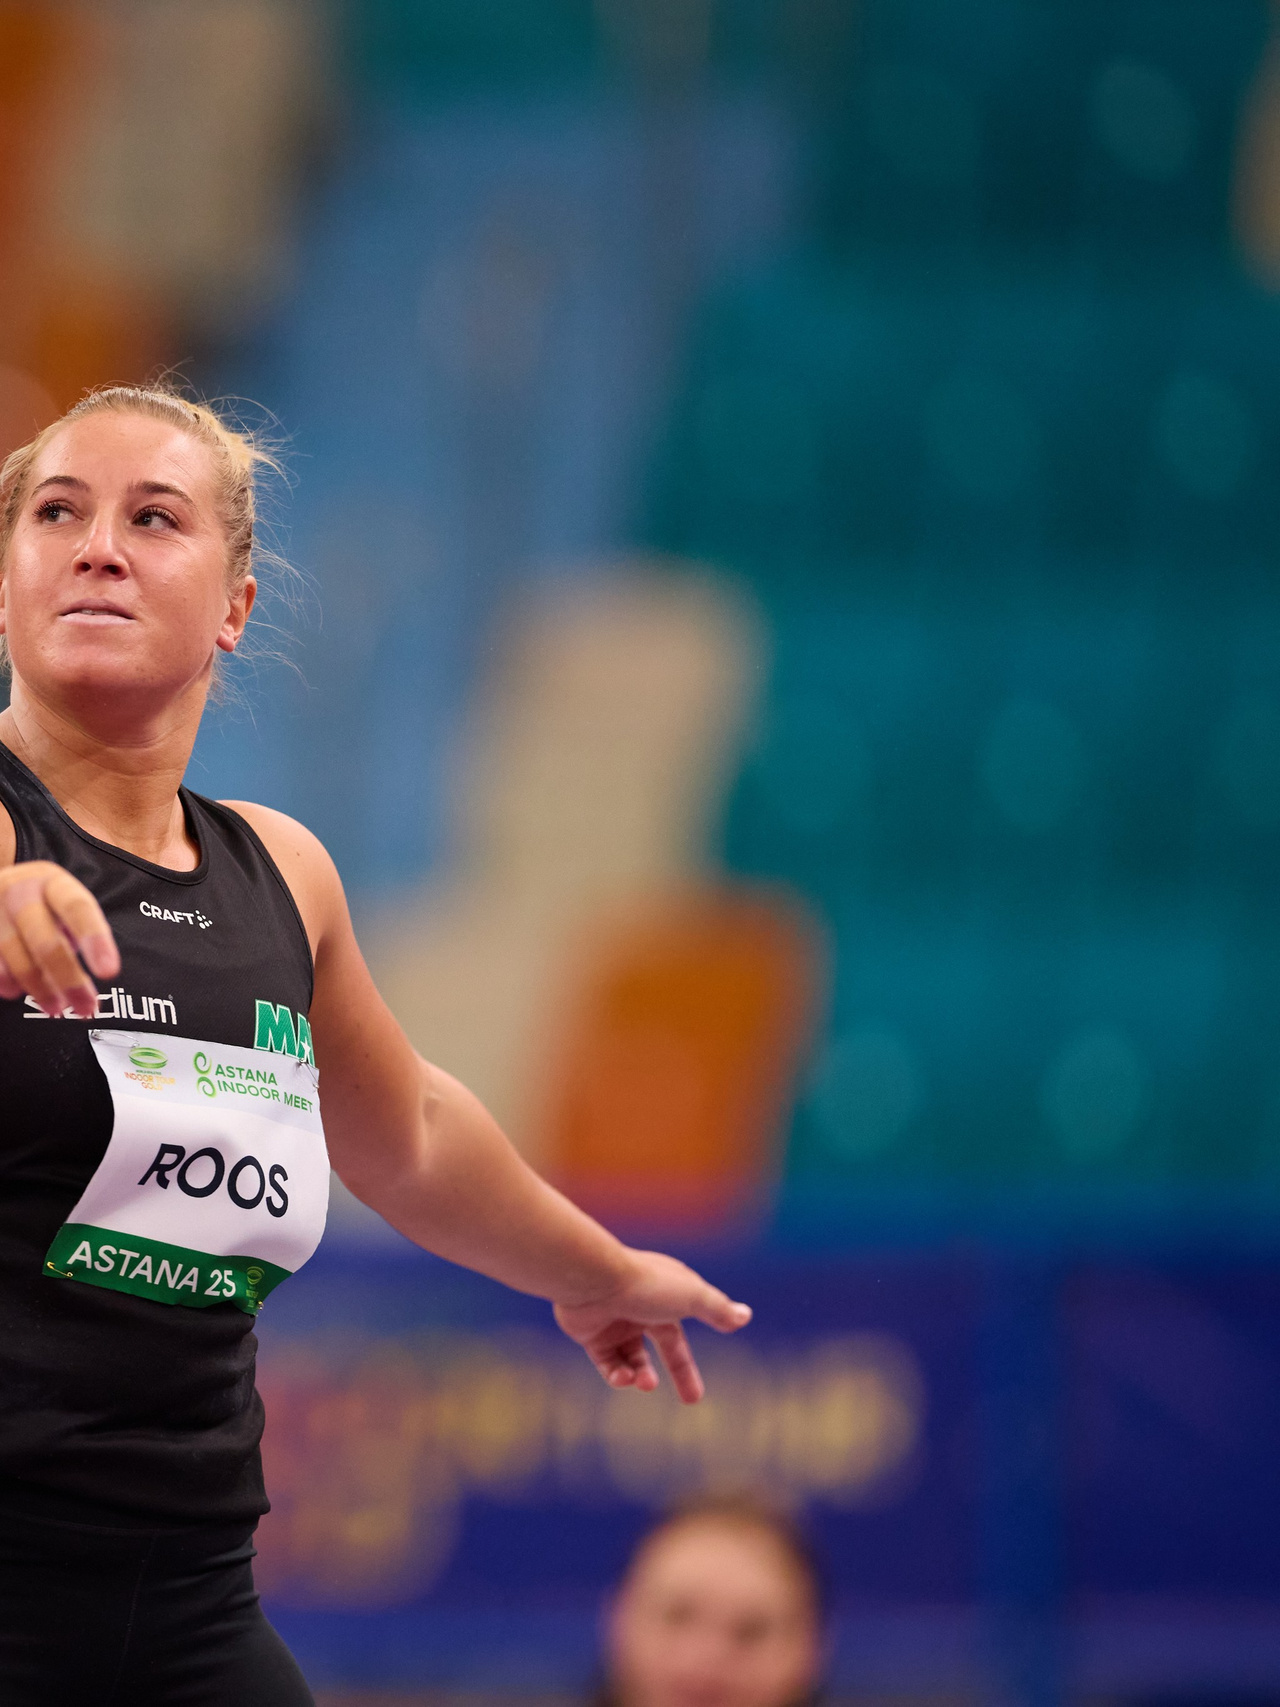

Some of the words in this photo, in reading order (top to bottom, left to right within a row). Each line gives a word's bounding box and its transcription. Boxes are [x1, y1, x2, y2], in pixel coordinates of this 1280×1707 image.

[139, 901, 195, 925] CRAFT
[23, 987, 178, 1025] sdium
[215, 1063, 278, 1086] ASTANA
[217, 1079, 281, 1103] INDOOR
[283, 1091, 313, 1114] MEET
[137, 1143, 289, 1218] ROOS
[66, 1240, 200, 1293] ASTANA
[204, 1269, 237, 1298] 25
